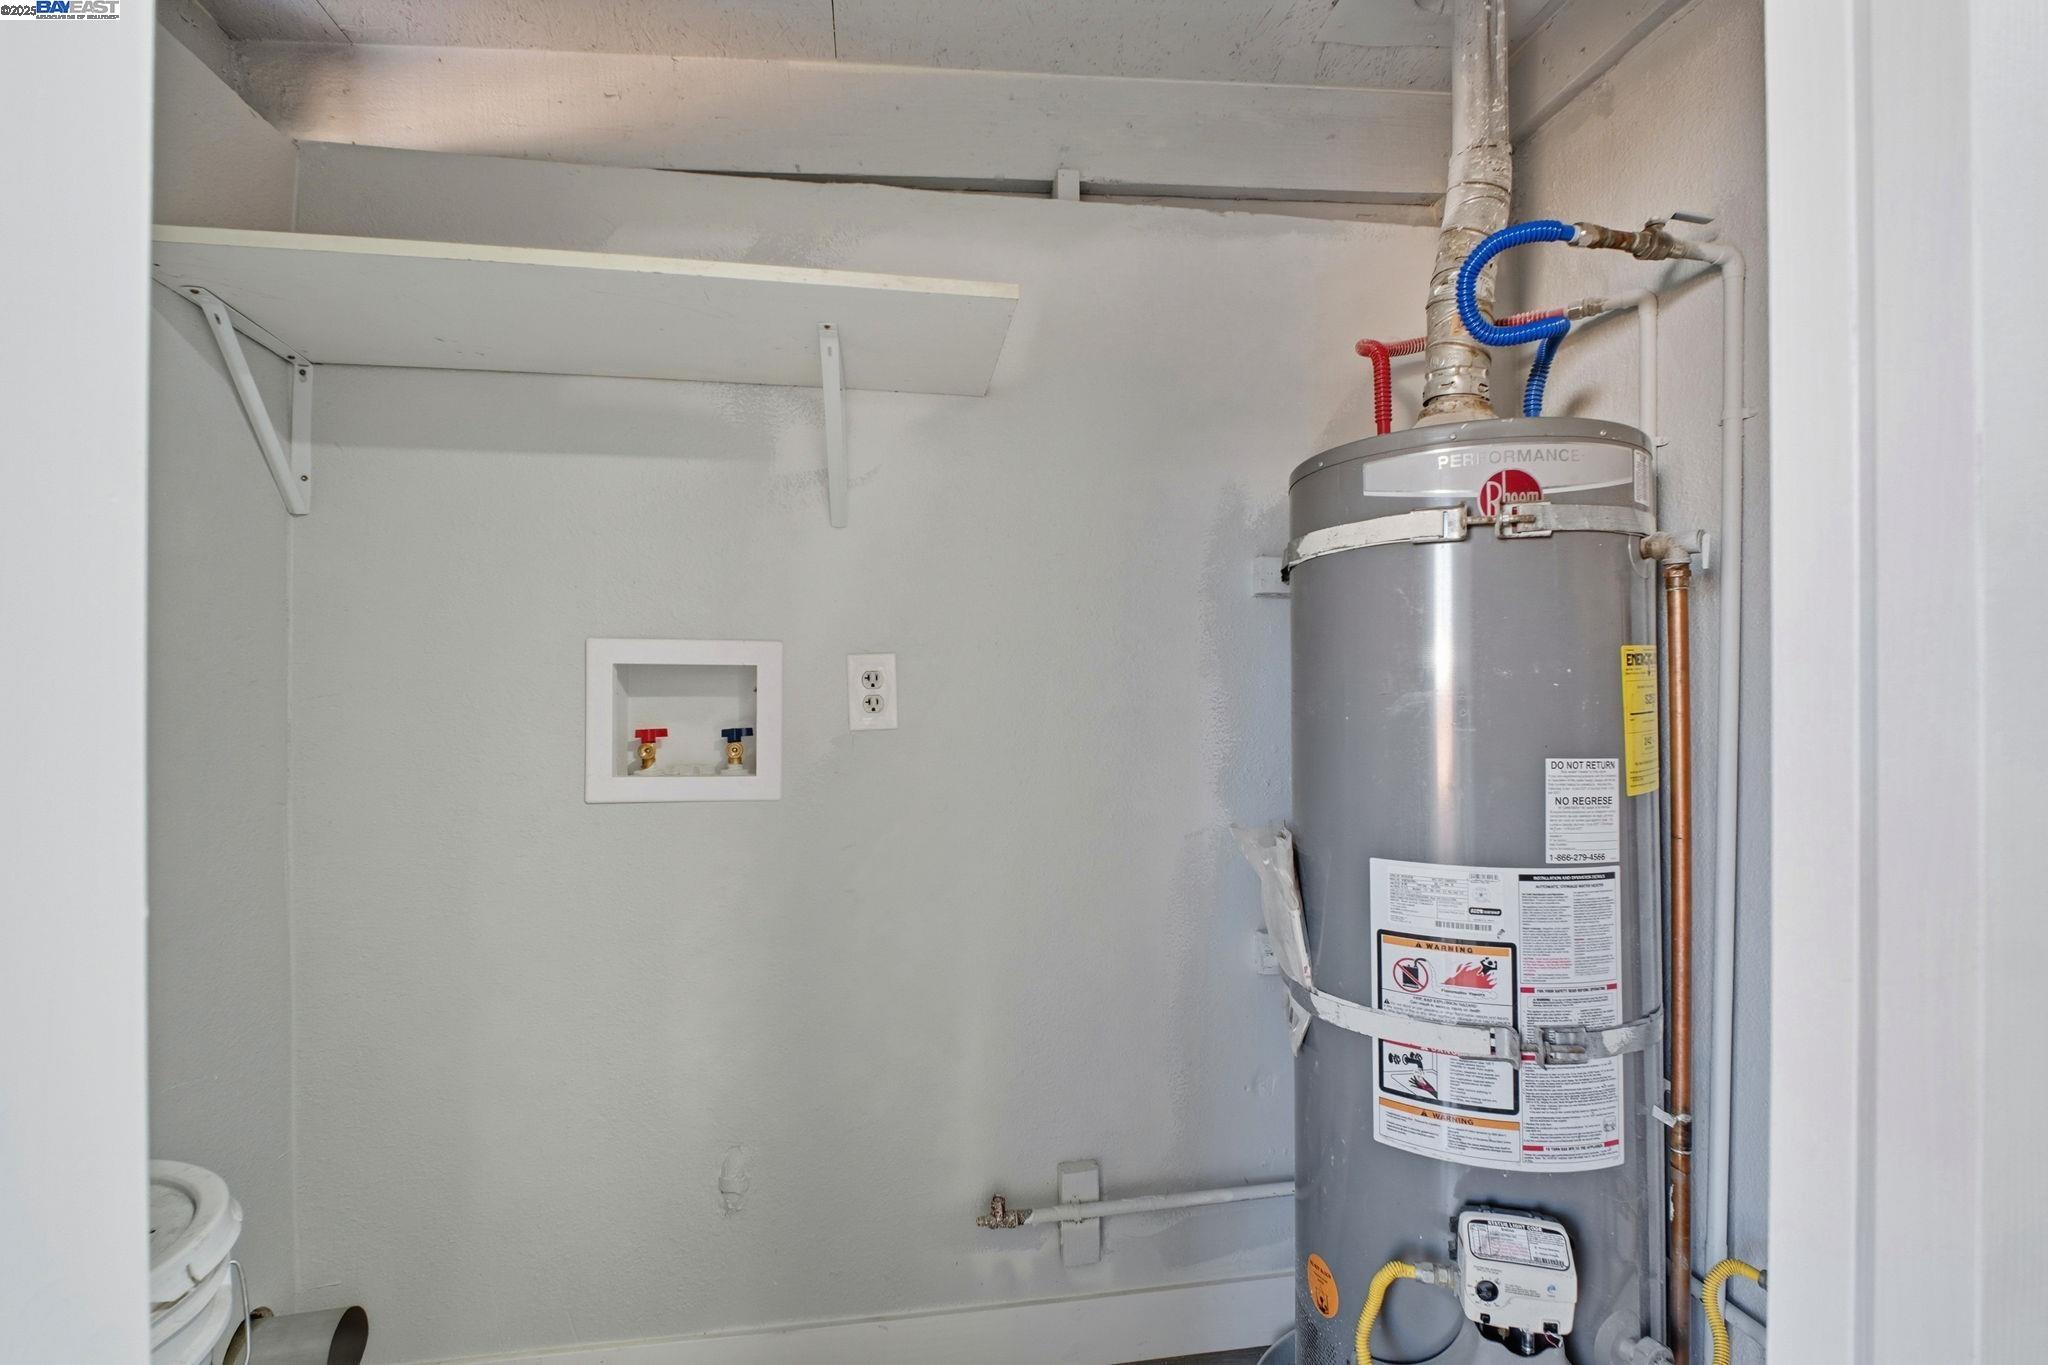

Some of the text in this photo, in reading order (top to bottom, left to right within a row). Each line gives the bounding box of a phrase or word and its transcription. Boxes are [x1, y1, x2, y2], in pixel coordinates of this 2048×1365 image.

[1438, 449, 1581, 470] PERFORMANCE
[1551, 761, 1615, 770] DO NOT RETURN
[1555, 796, 1613, 806] NO REGRESE
[1426, 943, 1474, 954] WARNING
[1432, 1112, 1475, 1126] WARNING
